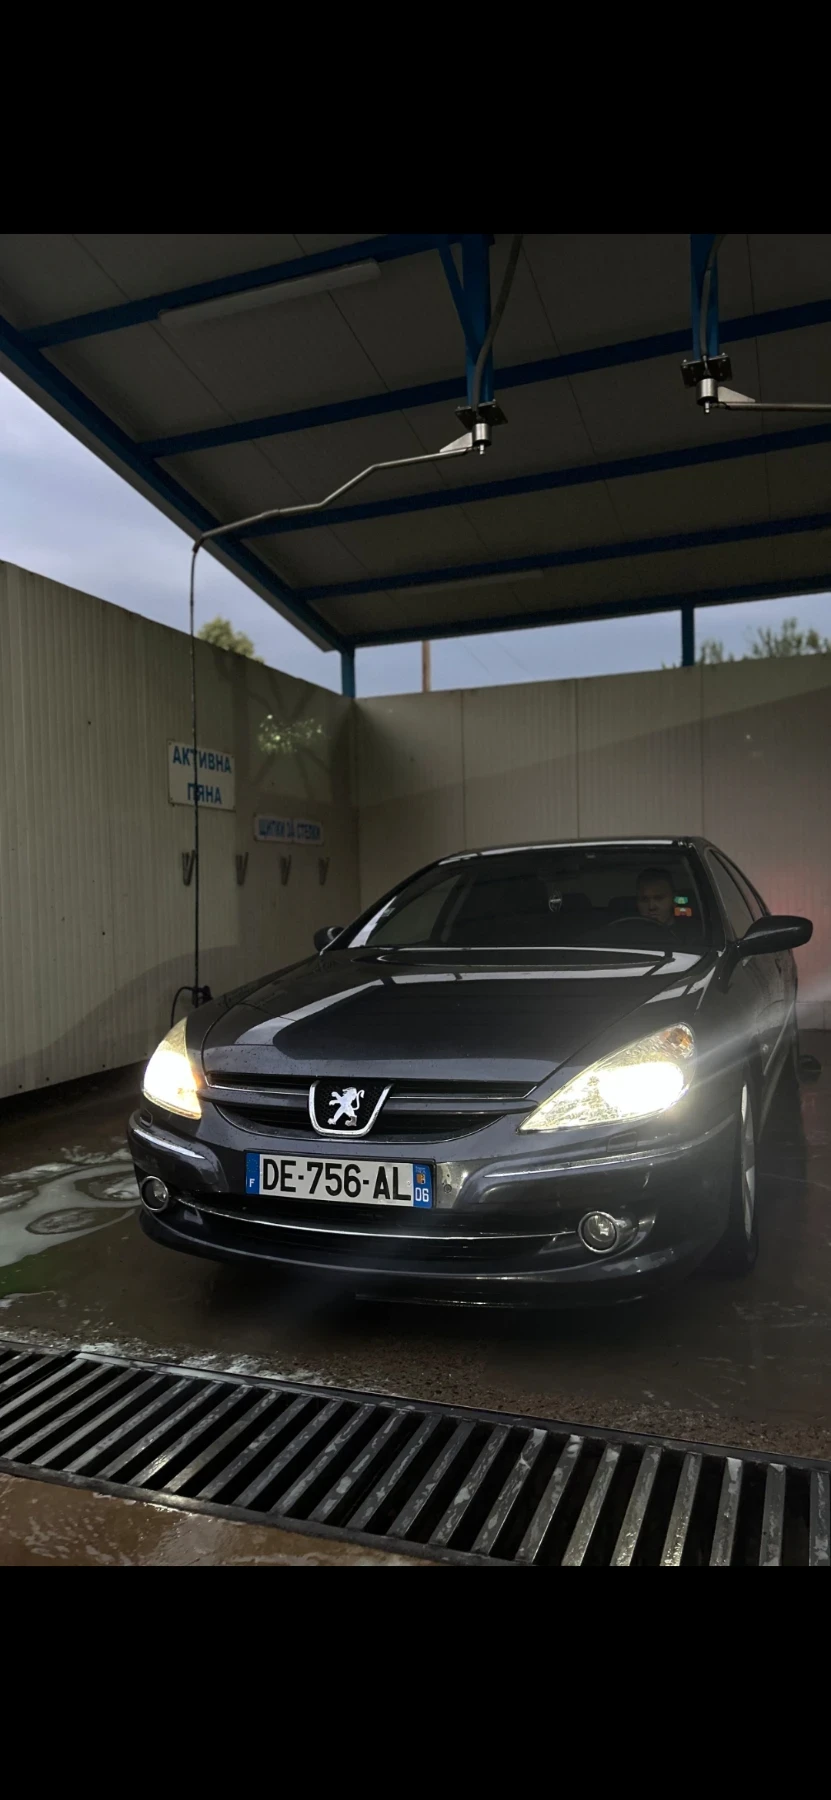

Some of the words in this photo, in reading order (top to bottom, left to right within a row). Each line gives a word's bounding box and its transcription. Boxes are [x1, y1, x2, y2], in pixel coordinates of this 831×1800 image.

[173, 746, 232, 774] АКТИВНА
[187, 782, 222, 805] ПЯНА
[249, 1178, 255, 1188] F
[262, 1158, 412, 1201] DE-756-AL
[415, 1187, 430, 1203] 06
